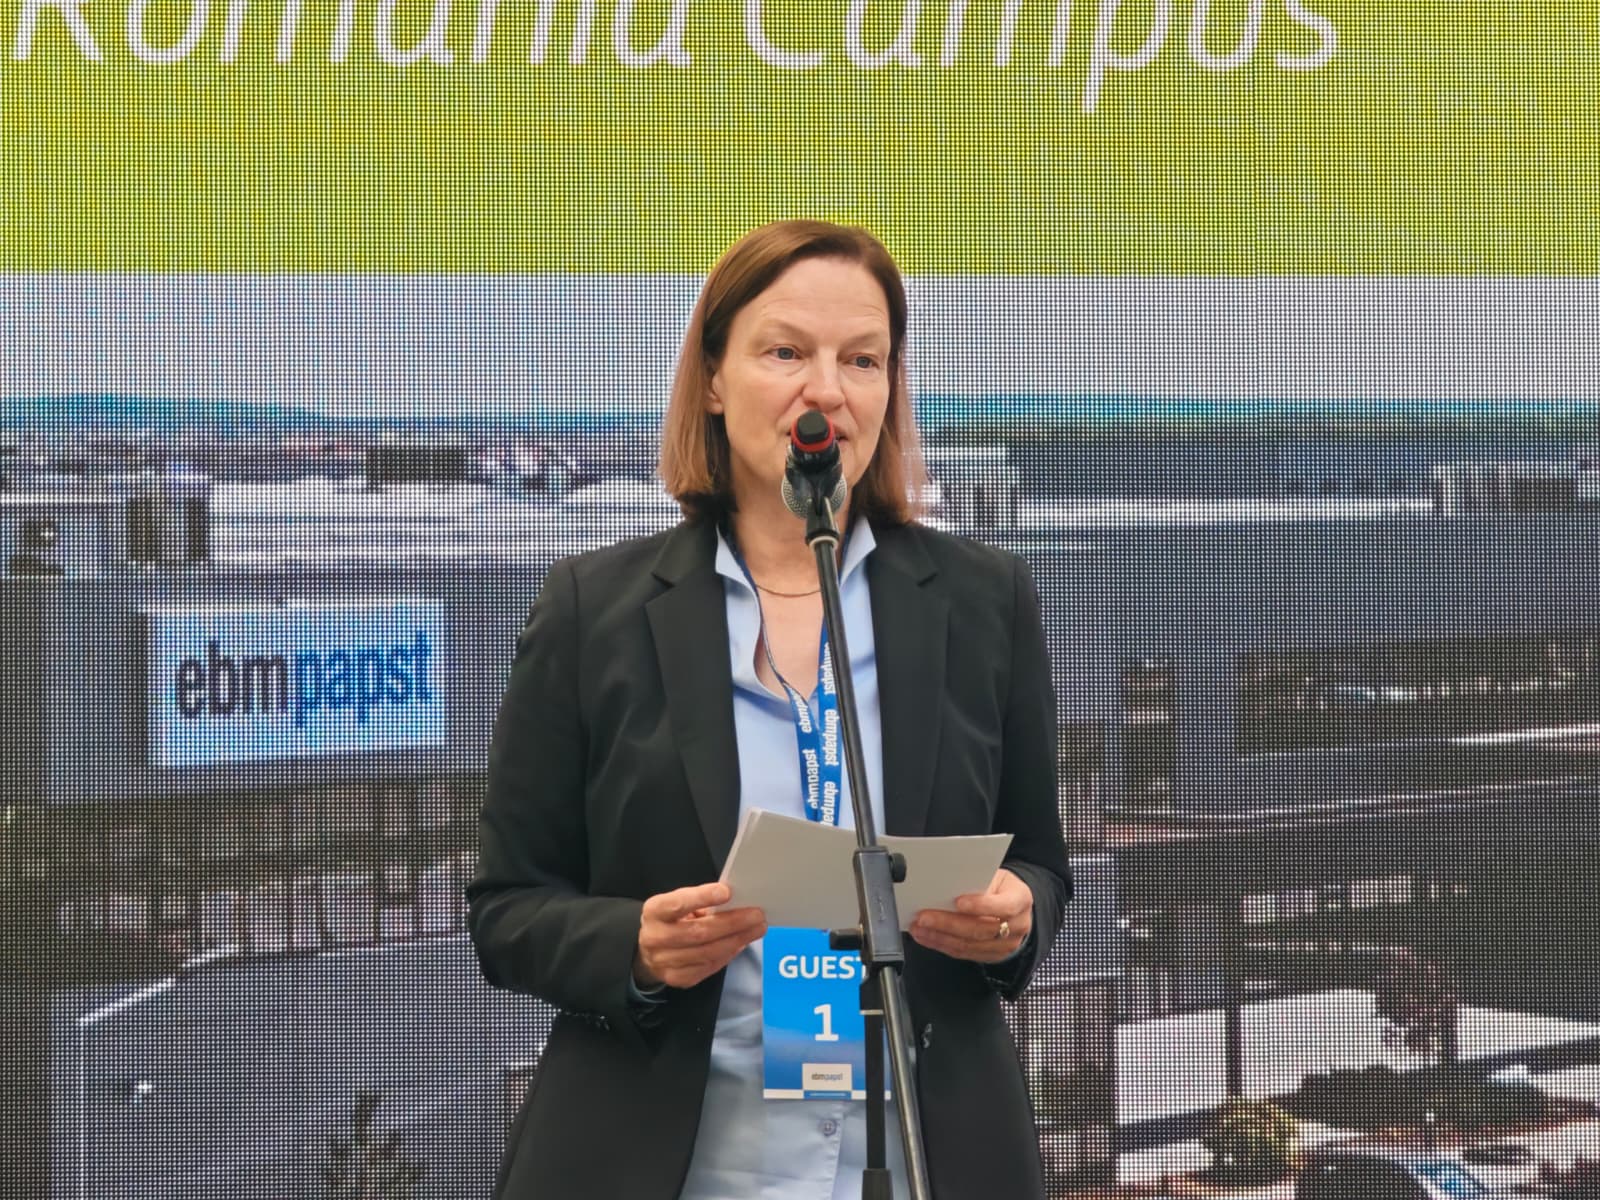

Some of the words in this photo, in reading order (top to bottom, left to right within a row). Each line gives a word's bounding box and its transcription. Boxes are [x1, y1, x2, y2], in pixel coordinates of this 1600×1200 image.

[175, 629, 432, 729] ebmpapst
[821, 709, 840, 767] ebmpapst
[801, 749, 820, 809] ebmpapst
[813, 1003, 840, 1042] 1
